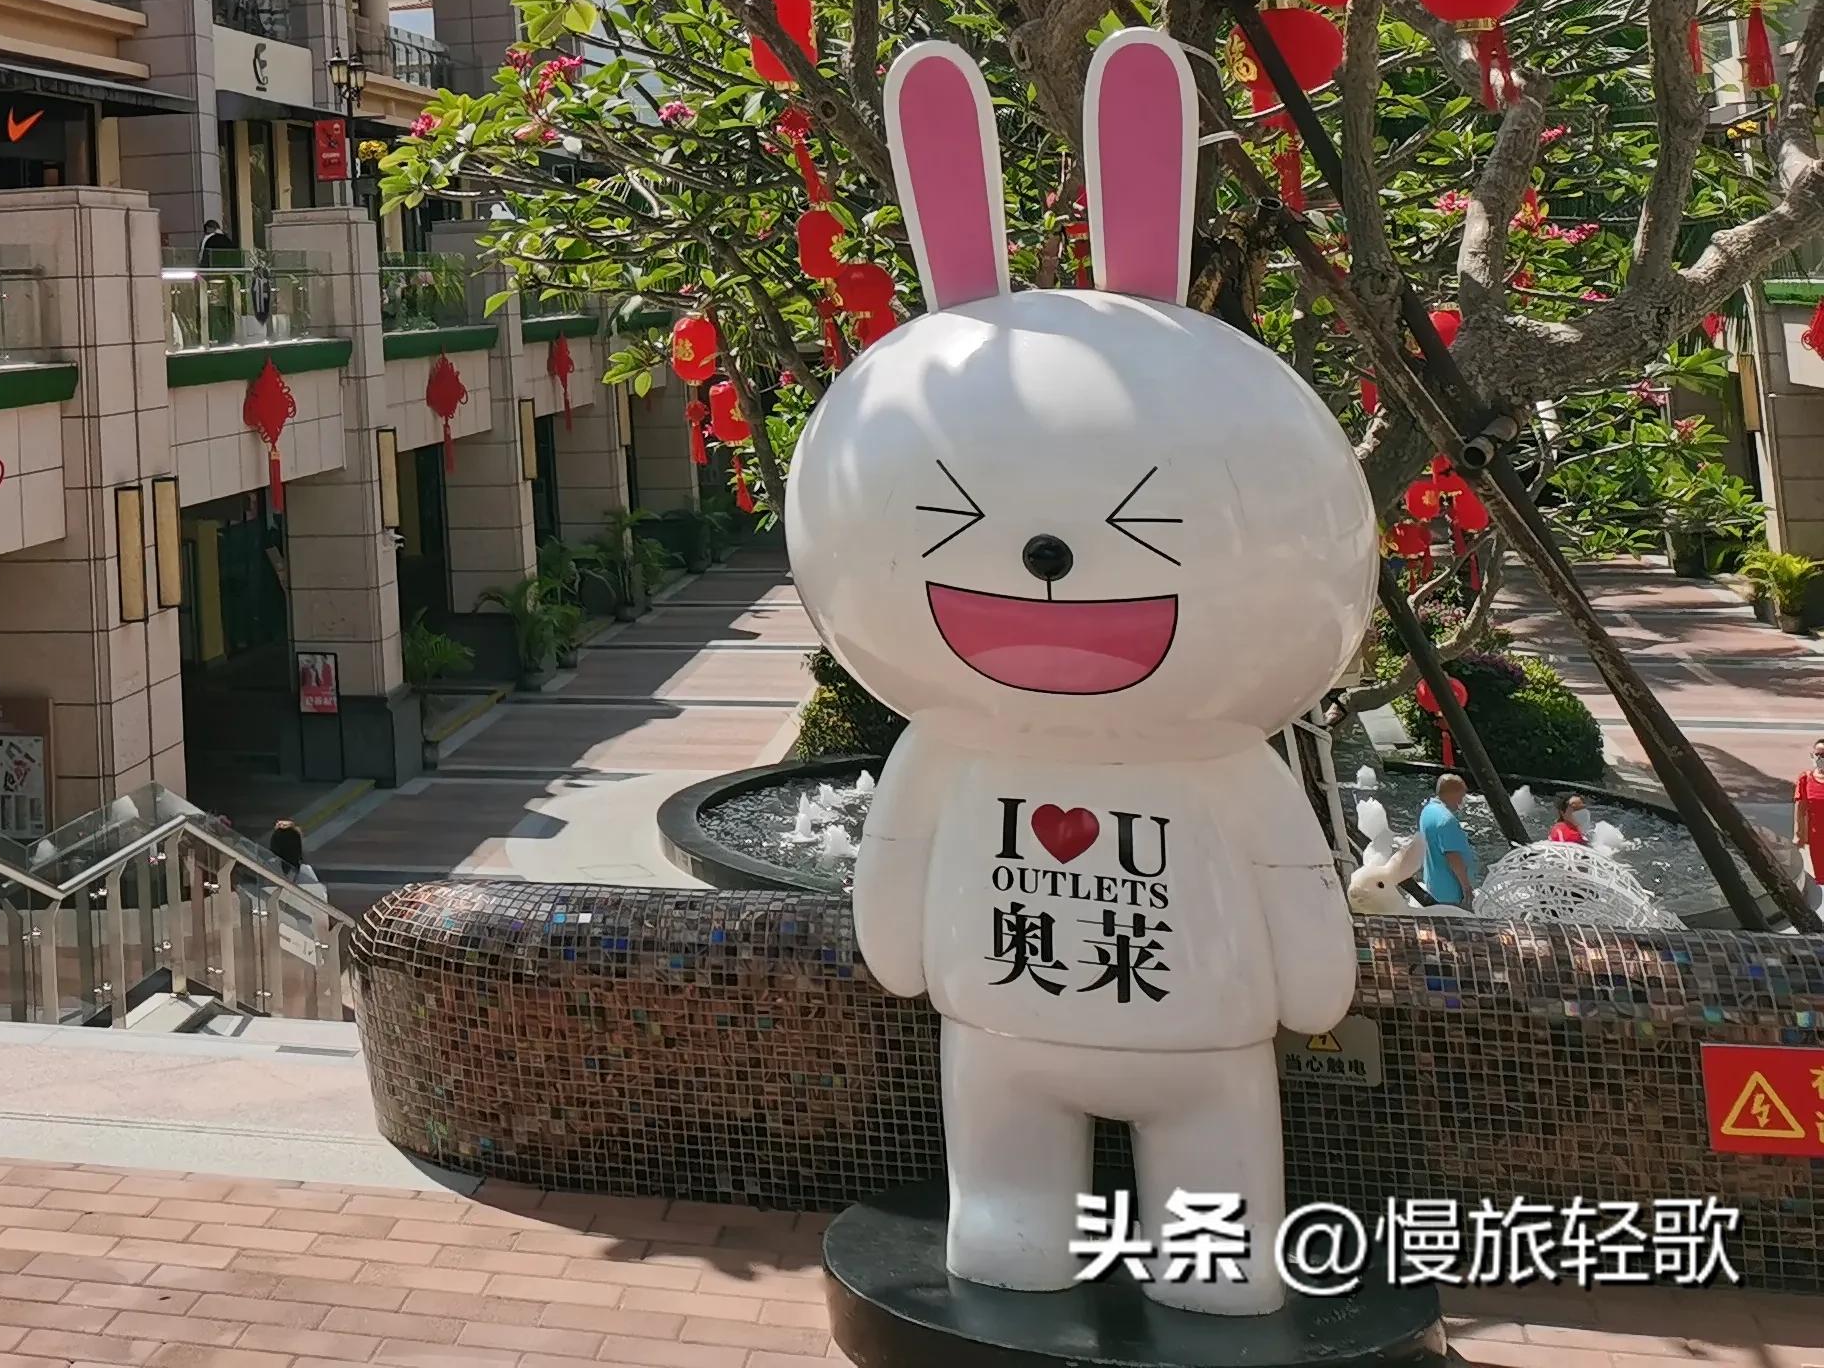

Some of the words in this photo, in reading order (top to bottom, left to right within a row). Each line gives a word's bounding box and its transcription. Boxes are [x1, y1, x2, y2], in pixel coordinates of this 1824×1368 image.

[995, 797, 1027, 860] I
[1108, 810, 1171, 878] U
[992, 865, 1169, 909] OUTLETS
[984, 901, 1174, 1004] 奥莱
